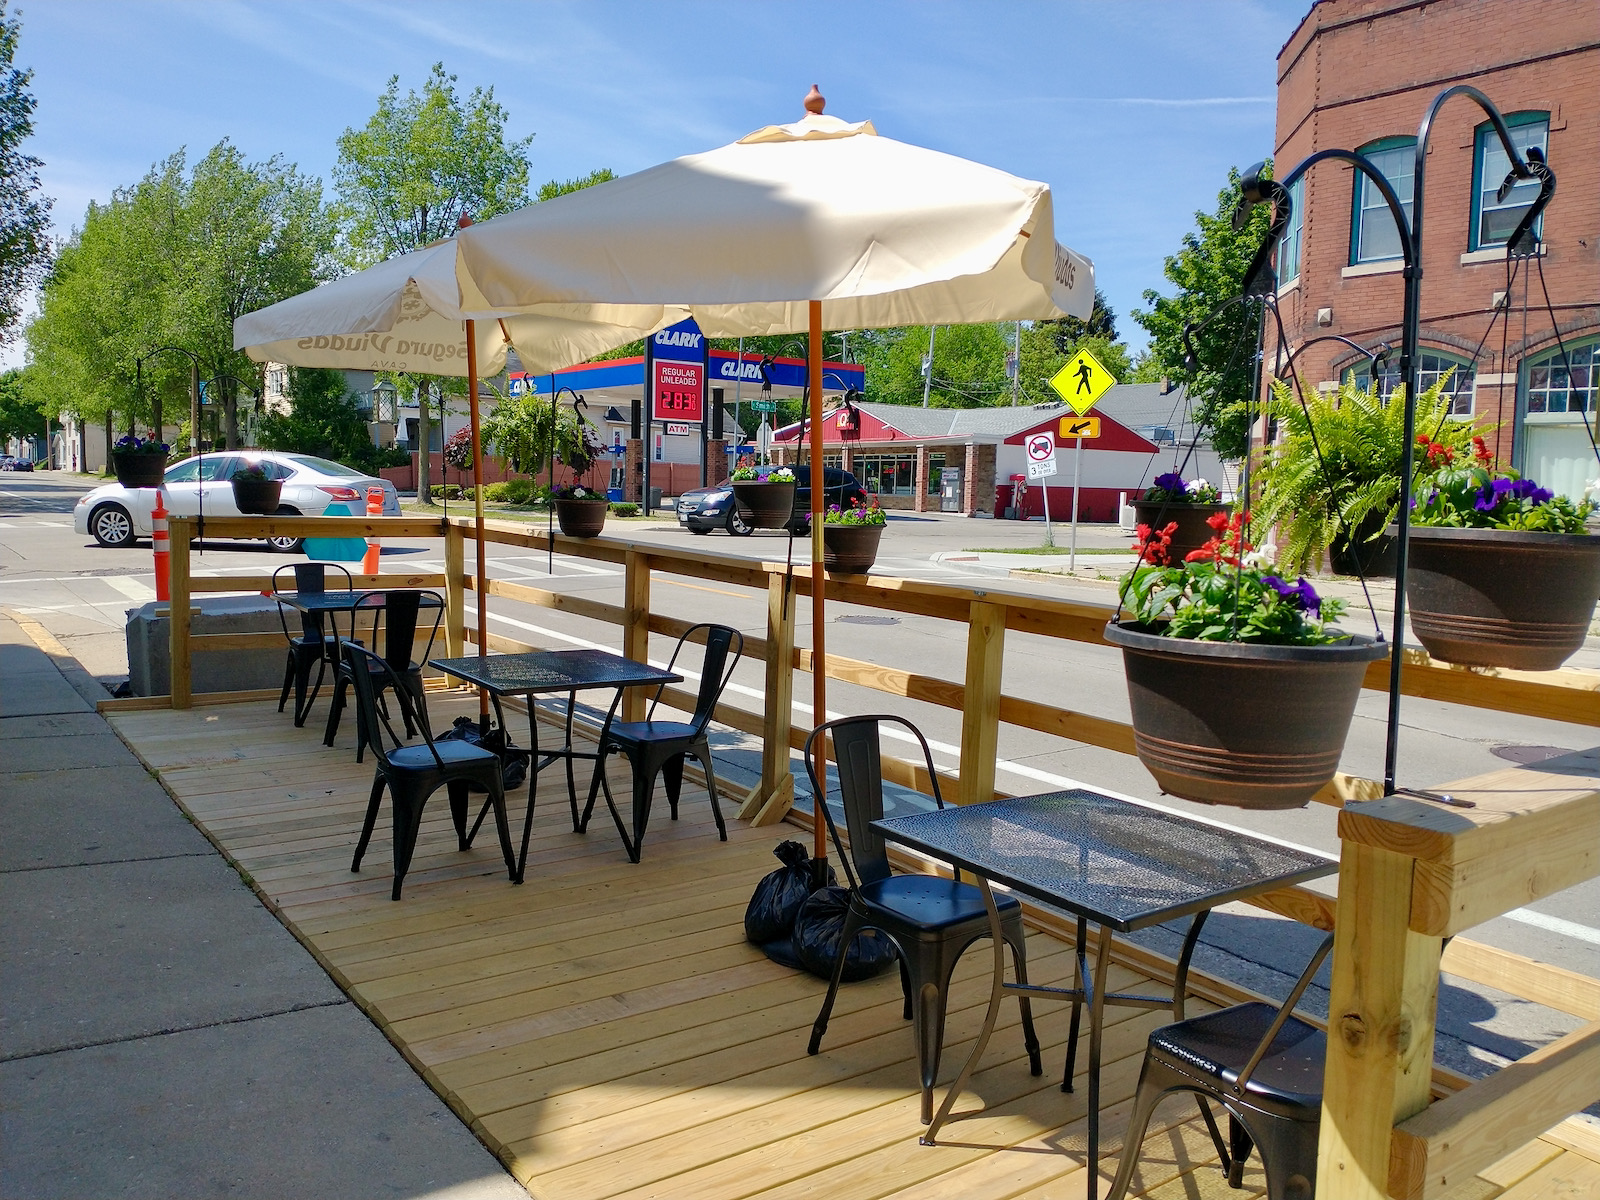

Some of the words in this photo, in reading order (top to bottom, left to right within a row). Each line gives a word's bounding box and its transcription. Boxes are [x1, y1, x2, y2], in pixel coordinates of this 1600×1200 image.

[655, 330, 702, 348] CLARK
[662, 367, 696, 377] REGULAR
[721, 361, 762, 379] CLARK
[660, 376, 697, 386] UNLEADED
[669, 425, 687, 433] ATM
[1031, 466, 1037, 476] 3
